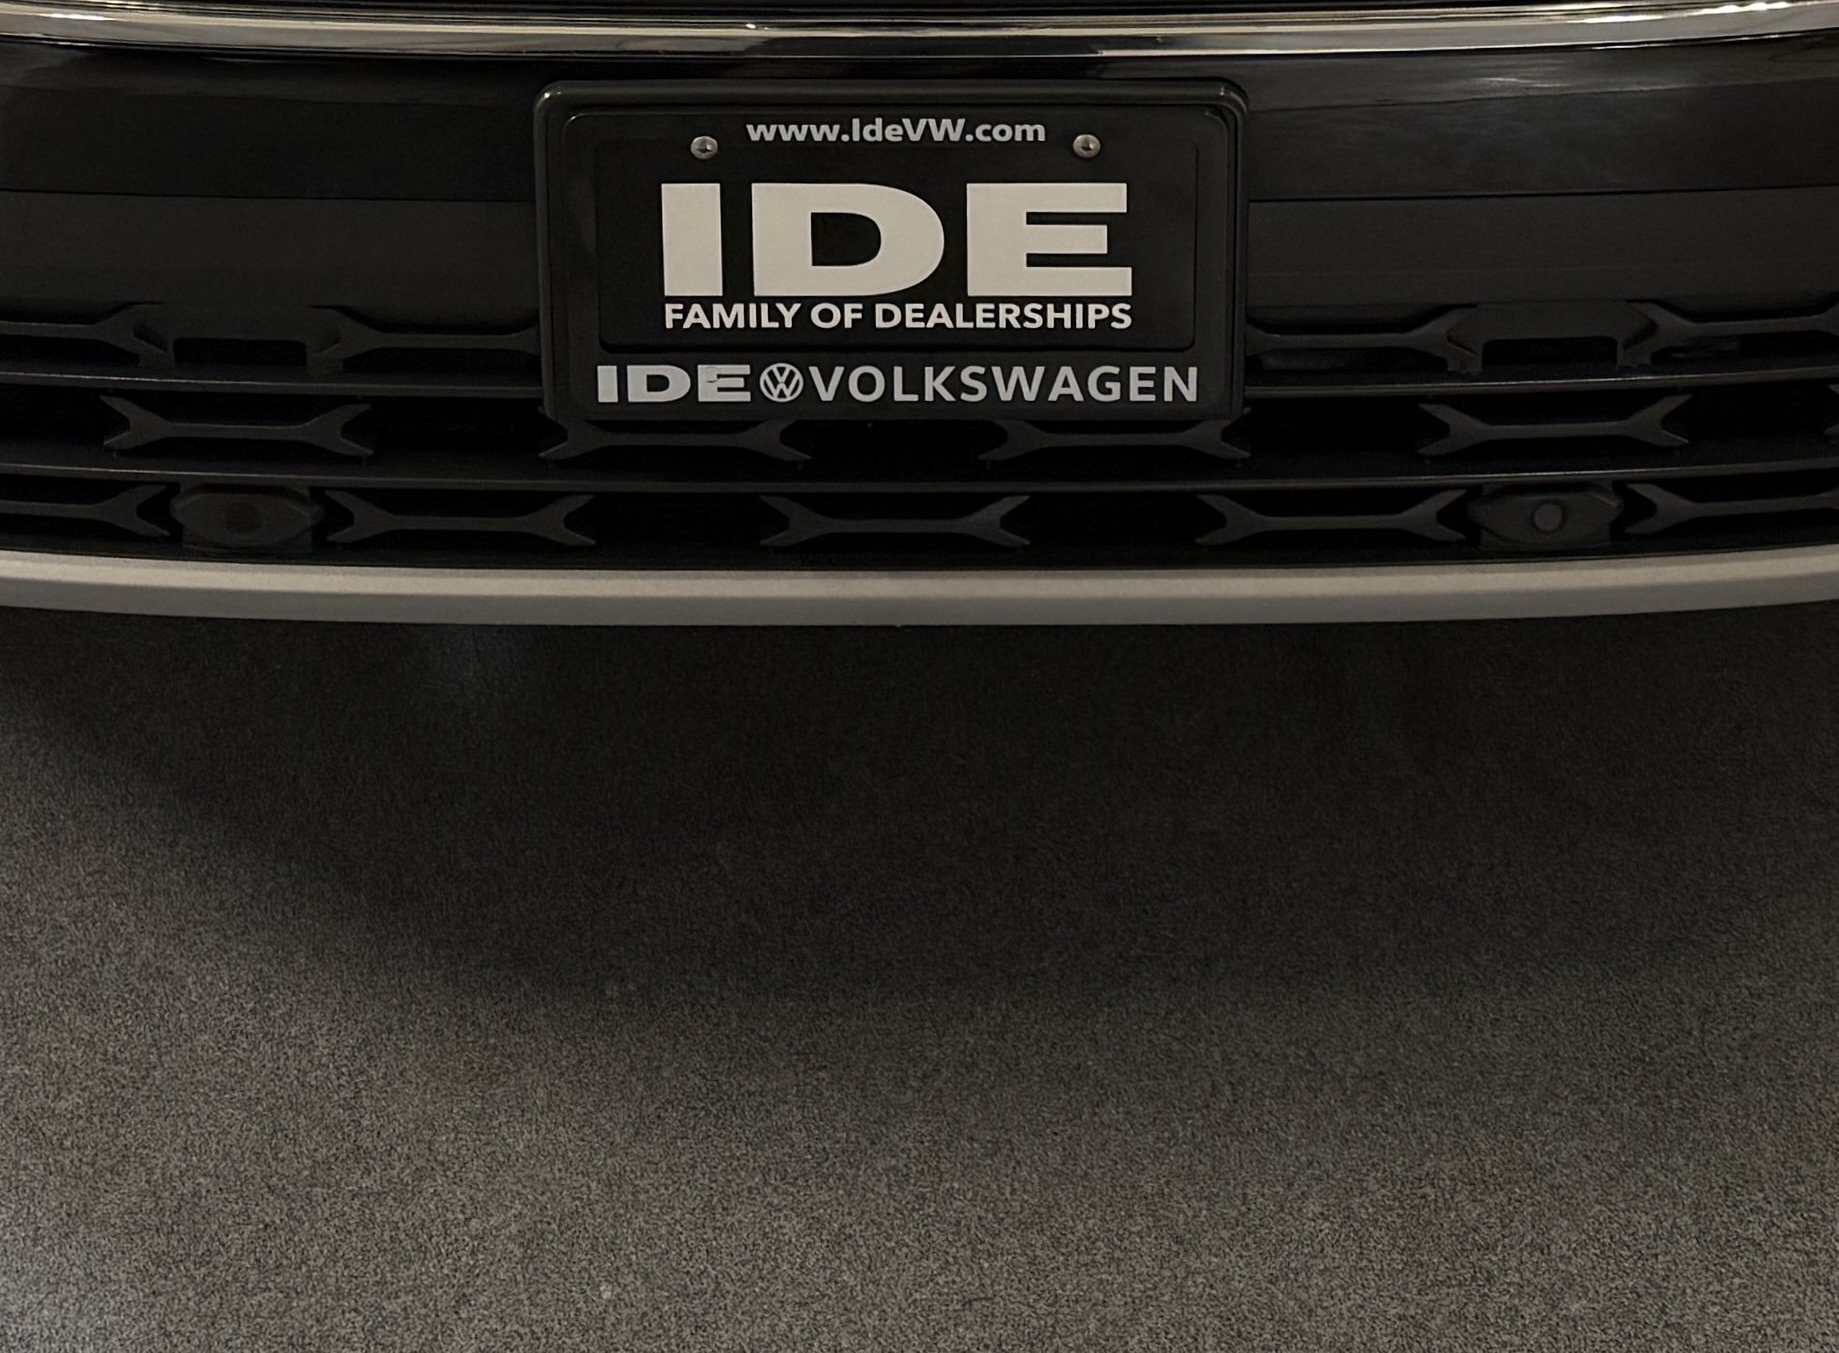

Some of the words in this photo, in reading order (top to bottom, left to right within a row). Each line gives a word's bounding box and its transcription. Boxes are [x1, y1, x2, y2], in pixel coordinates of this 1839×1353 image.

[746, 118, 1045, 141] www.IdeVW.com
[661, 183, 1132, 296] IDE
[665, 303, 801, 328] FAMILY
[811, 303, 863, 328] OF
[875, 303, 1131, 329] DEALERSHIPS
[597, 365, 751, 402] IDE
[809, 366, 1197, 402] VOLKSWAGEN
